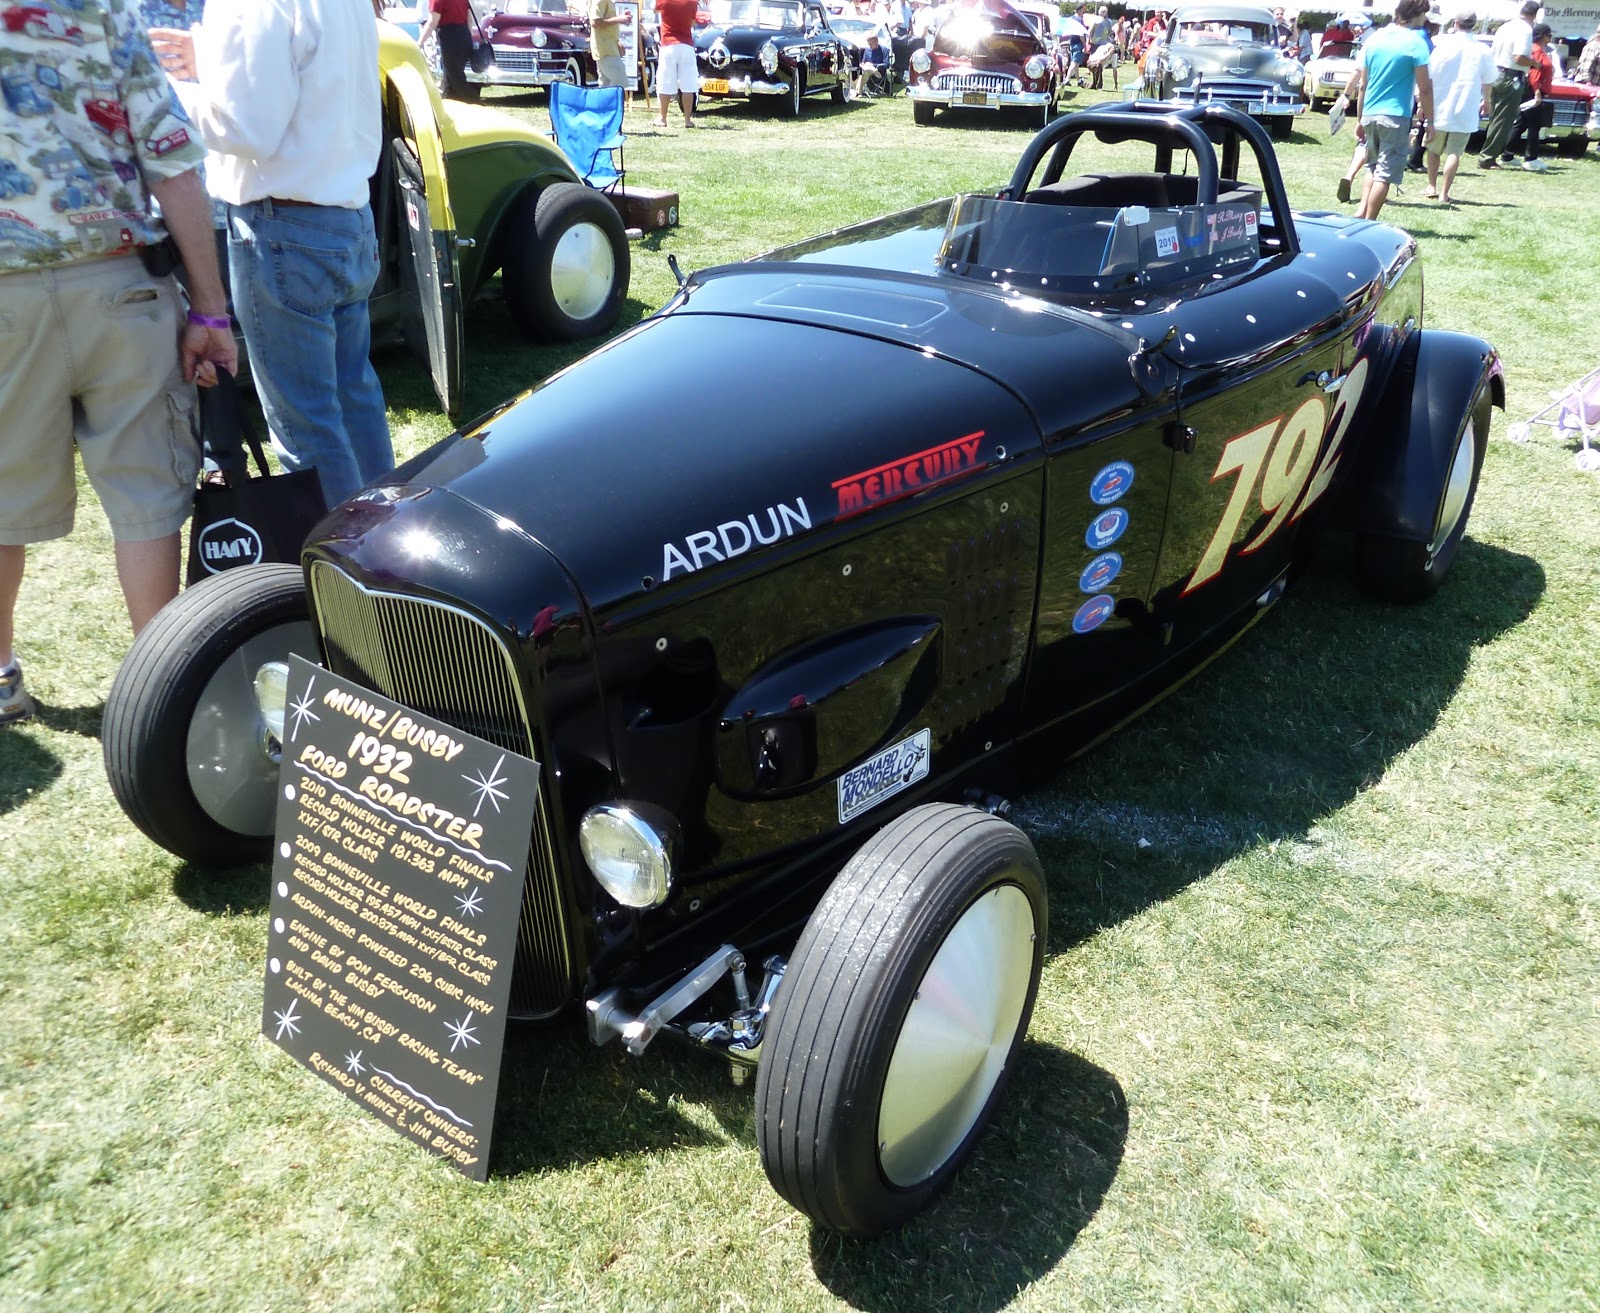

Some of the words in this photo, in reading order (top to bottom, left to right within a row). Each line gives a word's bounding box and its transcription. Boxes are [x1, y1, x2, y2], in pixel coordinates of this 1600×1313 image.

[1544, 7, 1561, 17] The
[1158, 236, 1176, 248] 2010
[836, 434, 984, 514] MERCURY
[1178, 355, 1369, 599] 792
[663, 496, 813, 582] ARDUN
[323, 687, 464, 761] MUNZ/BUSBY
[348, 731, 413, 784] 1932
[300, 744, 348, 779] FORD
[359, 776, 484, 849] ROADSTER
[842, 748, 900, 791] BERNARD
[842, 752, 914, 804] MONDELLO
[298, 810, 342, 844] XXF/STR
[342, 836, 379, 864] CLASS
[299, 793, 340, 822] RECORD
[340, 816, 386, 850] HOLDER
[389, 843, 436, 873] 181.363
[437, 868, 469, 889] MPH
[300, 776, 327, 798] 2010
[329, 793, 398, 836] BONNEVILLE
[400, 830, 446, 858] WORLD
[448, 854, 495, 884] FINALS
[293, 867, 326, 893] RECORD
[324, 886, 360, 914] HOLDER
[359, 907, 399, 936] 200.875
[395, 930, 419, 947] MPH
[457, 962, 492, 986] CLASS
[294, 853, 328, 877] RECORD
[326, 872, 365, 902] HOLDER
[365, 894, 402, 919] 195.457
[398, 913, 422, 931] MPH
[462, 947, 498, 970] CLASS
[295, 834, 321, 857] 2009
[322, 852, 391, 898] BONNEVILLE
[393, 892, 438, 920] WORLD
[439, 916, 487, 946] FINALS
[285, 976, 323, 1008] LAGUNA
[287, 935, 310, 953] AND
[310, 949, 343, 974] DAVID
[344, 971, 385, 998] BUSBY
[289, 919, 328, 949] ENGINE
[328, 944, 346, 957] BY
[345, 955, 372, 976] DON
[373, 972, 437, 1014] FERGUSON
[291, 892, 357, 939] ARDUN-MERC
[357, 933, 408, 968] POWERED
[409, 963, 433, 983] 296
[434, 977, 464, 1000] CUBIC
[463, 994, 495, 1015] INCH
[285, 960, 314, 981] BUILT
[312, 978, 327, 991] BY
[347, 1003, 366, 1019] JIM
[364, 1011, 400, 1037] BUSBY
[397, 1033, 440, 1065] RACING
[308, 1051, 356, 1088] RICHARD
[355, 1083, 366, 1097] V.
[364, 1091, 398, 1118] MUNZ
[409, 1121, 432, 1141] JIM
[369, 1075, 426, 1114] CURRENT
